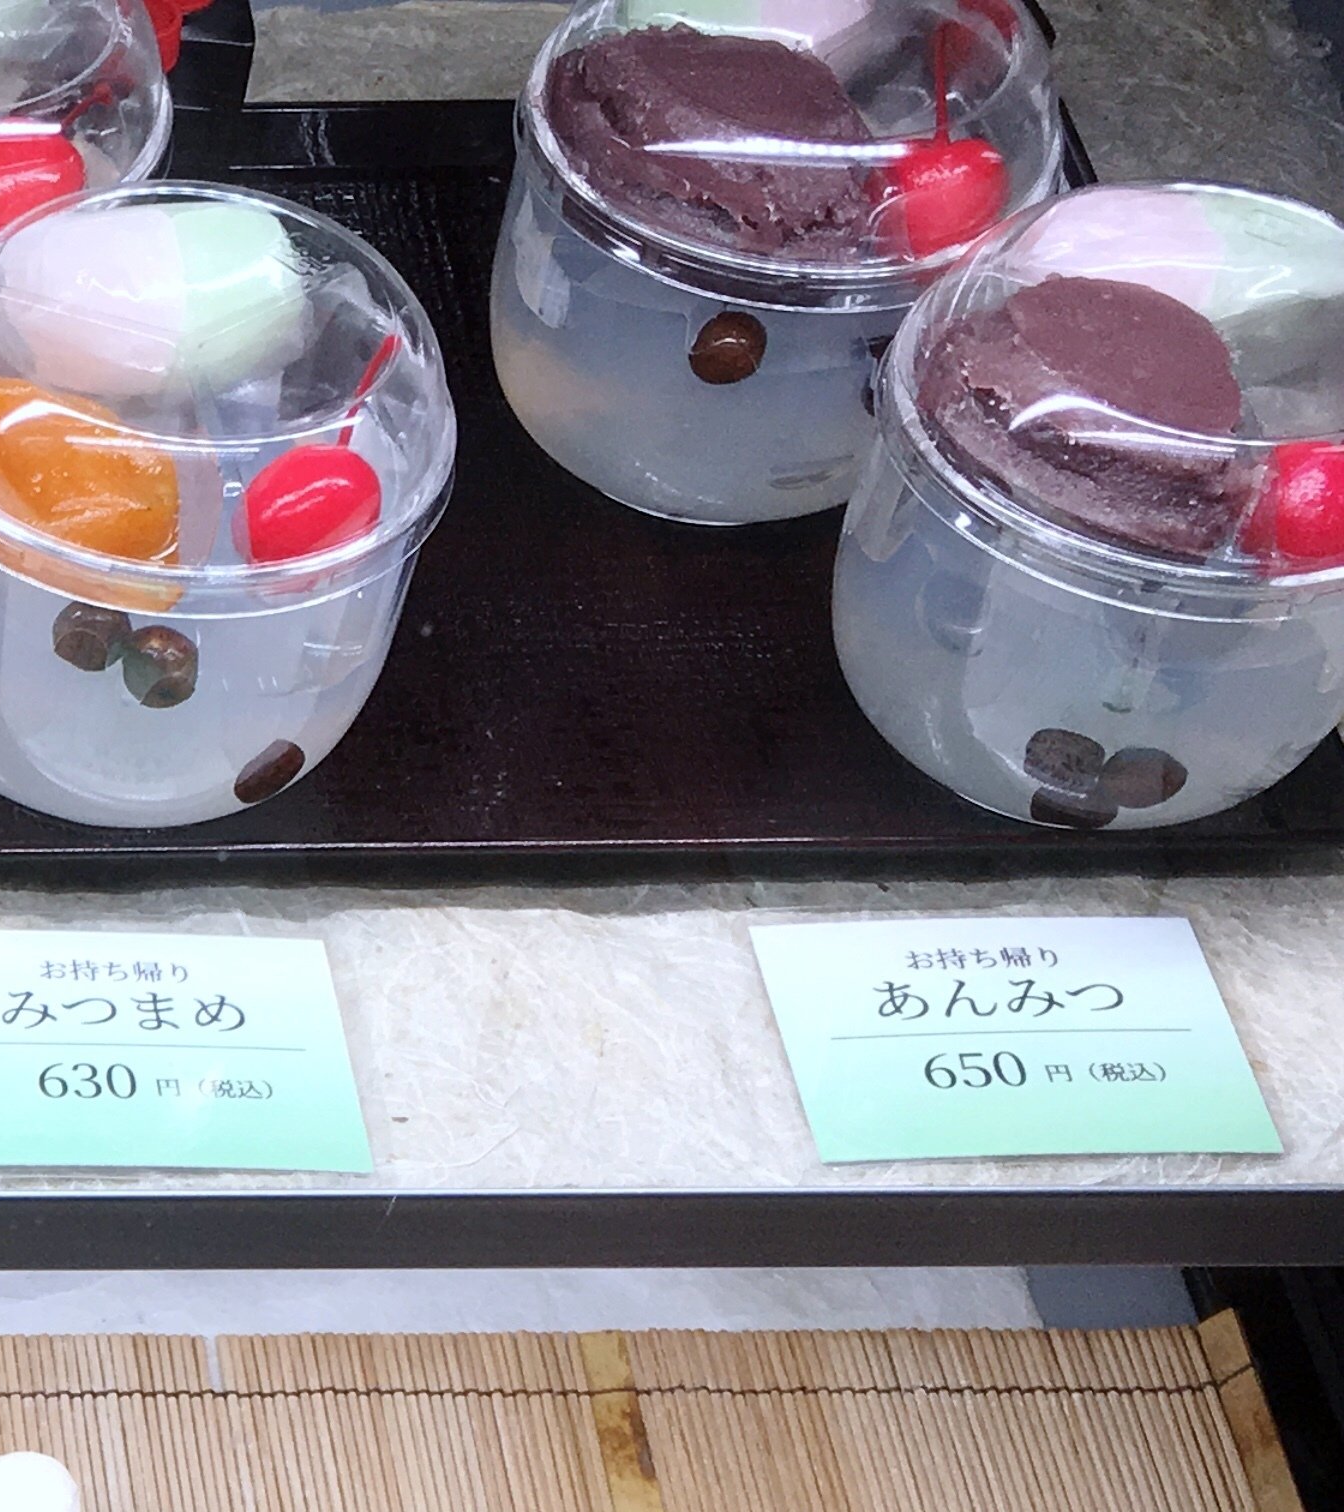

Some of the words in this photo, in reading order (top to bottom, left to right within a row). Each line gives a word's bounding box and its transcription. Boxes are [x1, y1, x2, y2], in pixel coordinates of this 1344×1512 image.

[40, 960, 189, 983] お持ち帰り
[906, 946, 1059, 970] お持ち帰り
[1, 991, 246, 1031] みつまめ
[872, 979, 1124, 1020] あんみつ
[38, 1062, 137, 1100] 630
[924, 1050, 1027, 1089] 650
